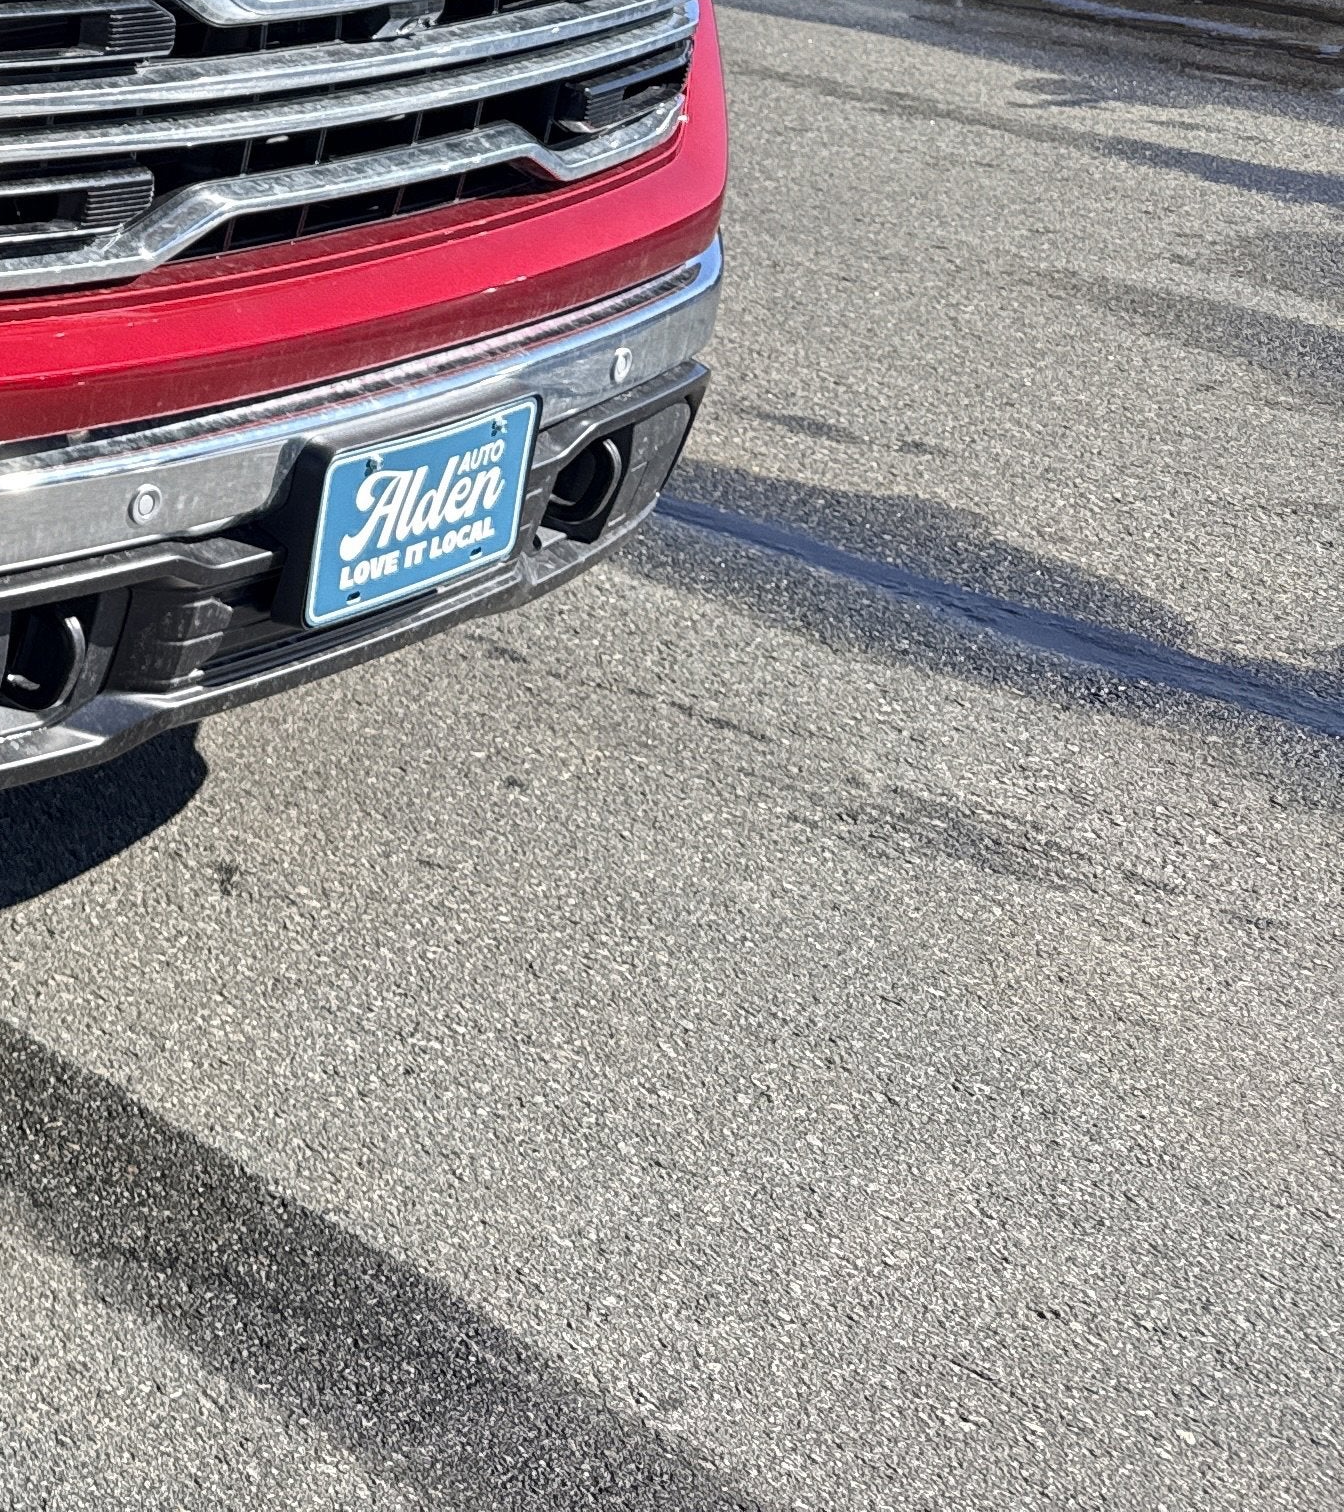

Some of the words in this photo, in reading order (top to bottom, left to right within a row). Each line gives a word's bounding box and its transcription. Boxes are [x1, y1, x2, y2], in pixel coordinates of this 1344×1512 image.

[458, 438, 506, 476] AUTO
[339, 455, 507, 562] Alden
[339, 550, 400, 591] LOVE
[403, 541, 429, 570] IT
[429, 516, 496, 560] LOCAL
